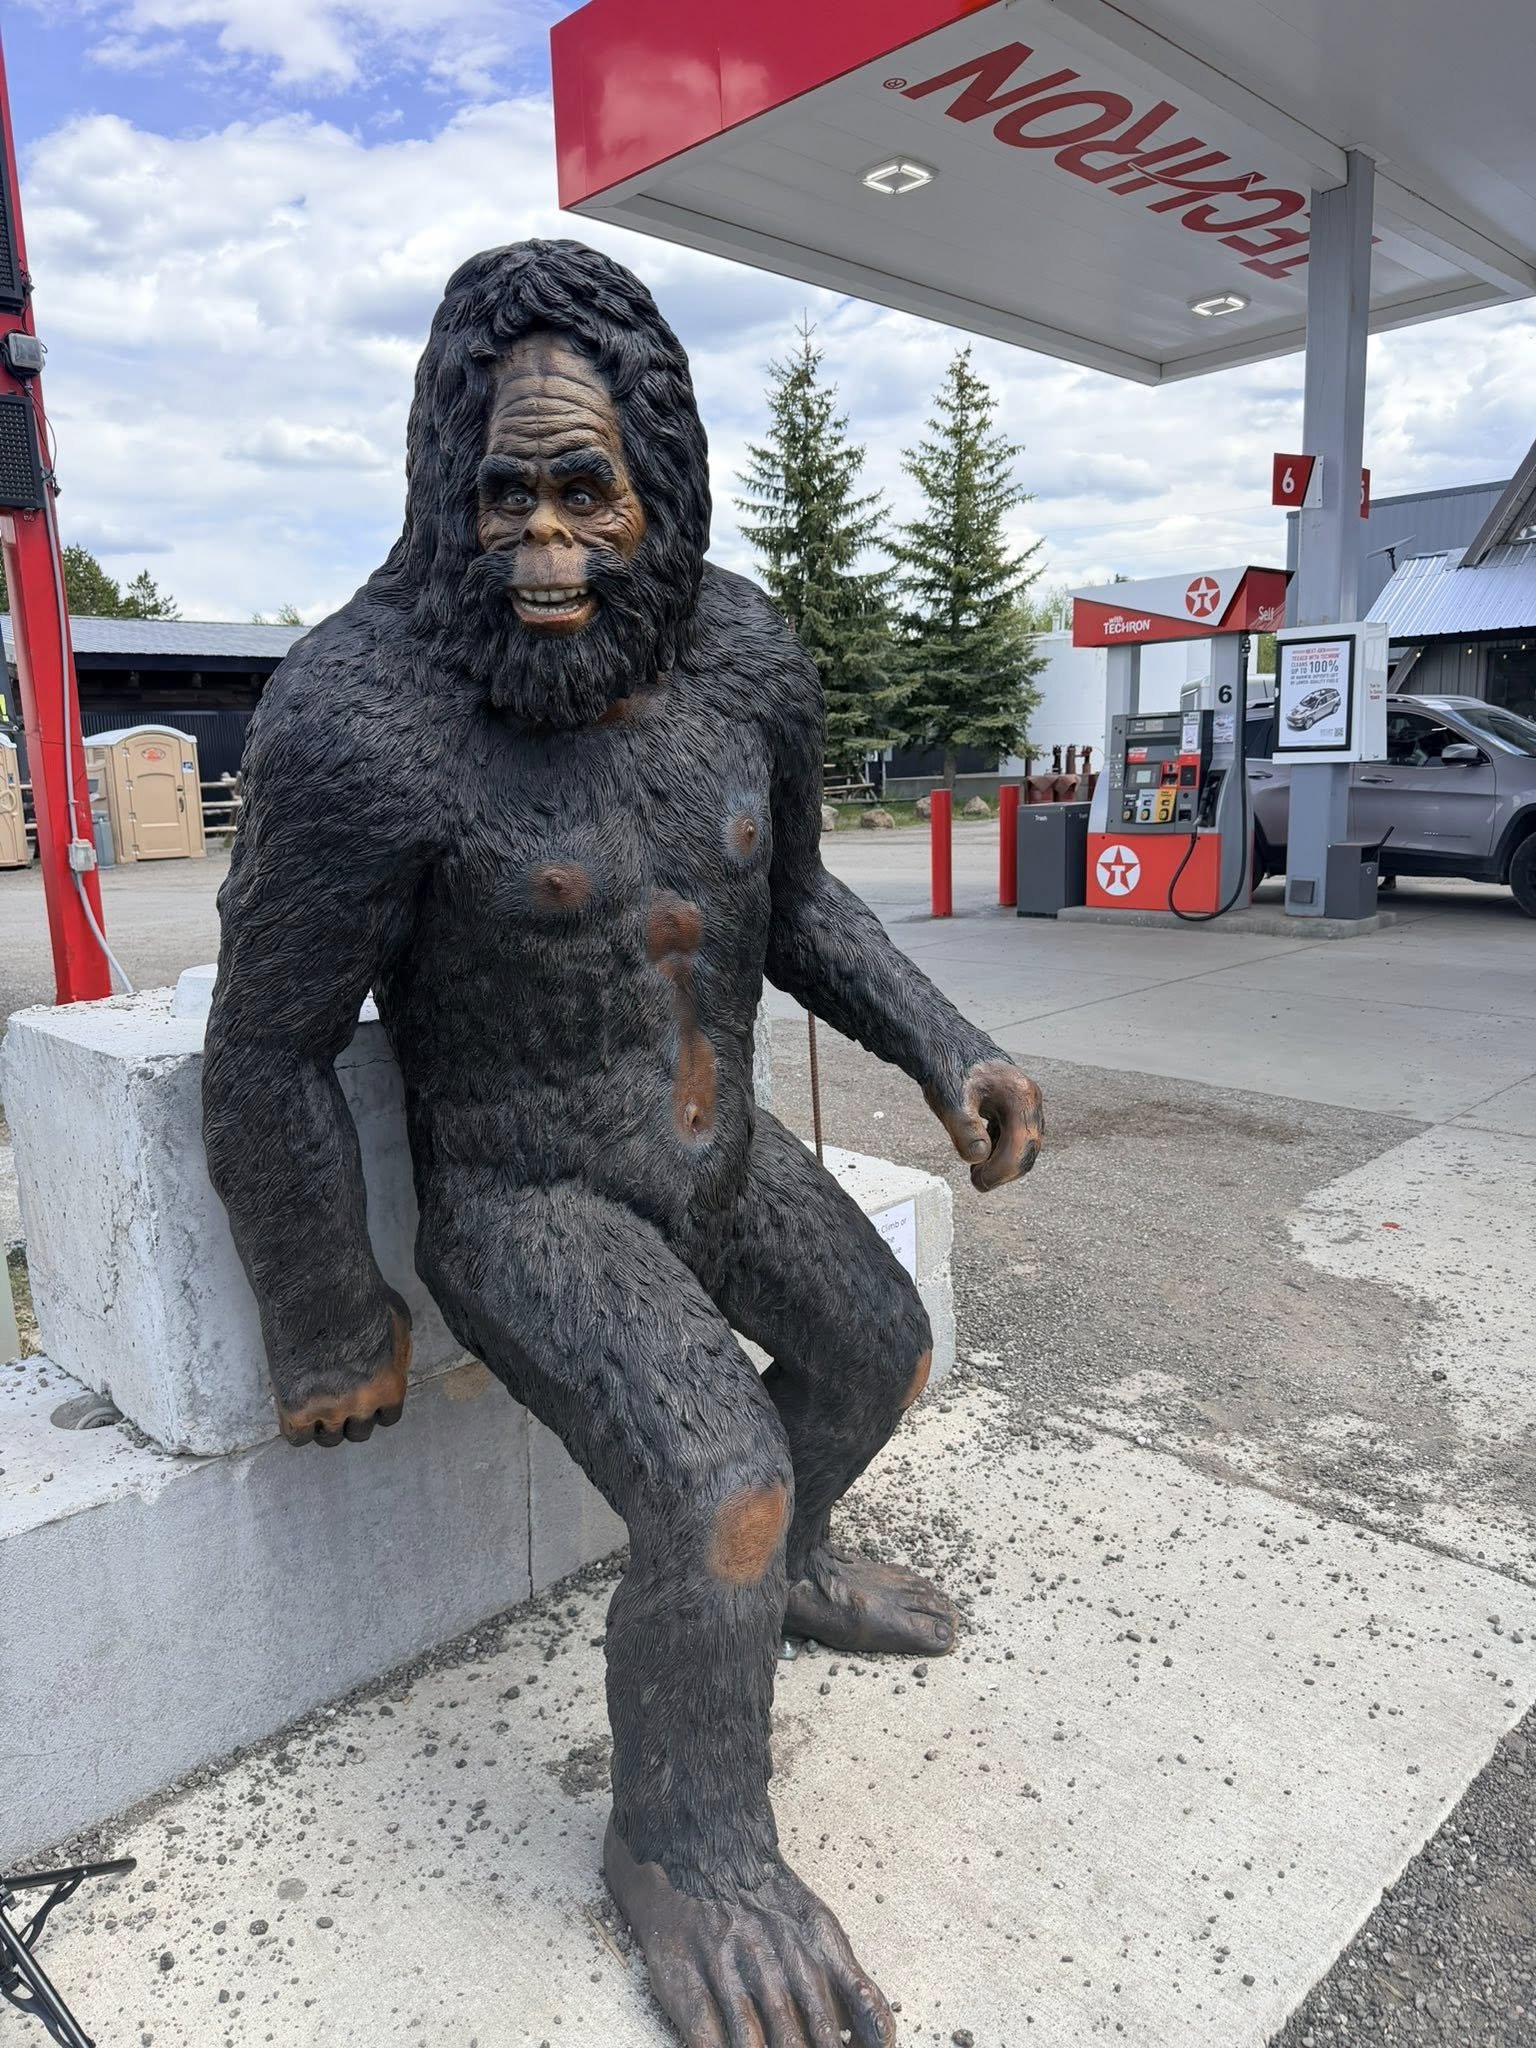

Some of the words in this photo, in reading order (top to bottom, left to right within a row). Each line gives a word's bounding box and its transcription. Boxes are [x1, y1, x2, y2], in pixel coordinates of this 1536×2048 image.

[1282, 467, 1295, 494] 6
[1258, 606, 1274, 622] Self
[1103, 619, 1151, 635] TECHRON
[1310, 660, 1339, 673] 100%
[1218, 684, 1232, 704] 6
[881, 1220, 900, 1233] Climb
